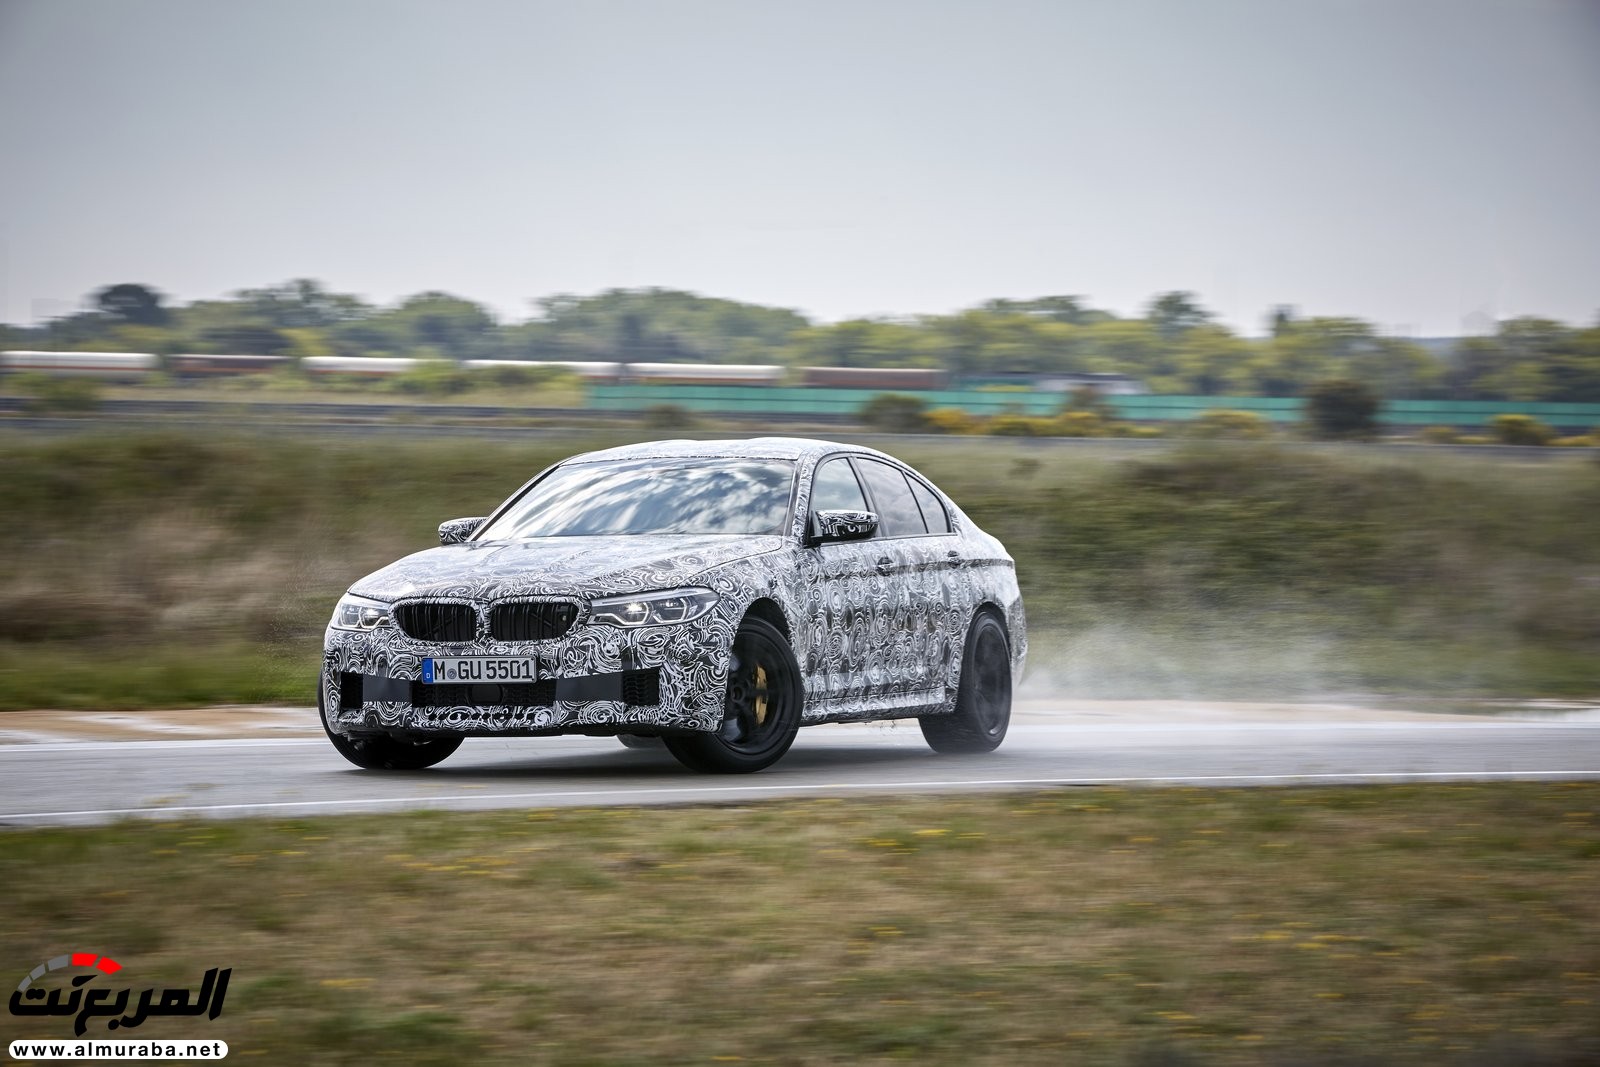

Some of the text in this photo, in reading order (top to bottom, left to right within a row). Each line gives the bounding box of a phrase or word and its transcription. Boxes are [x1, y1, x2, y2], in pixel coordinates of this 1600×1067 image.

[433, 660, 445, 680] M
[457, 660, 482, 680] GU
[486, 660, 533, 680] 5501
